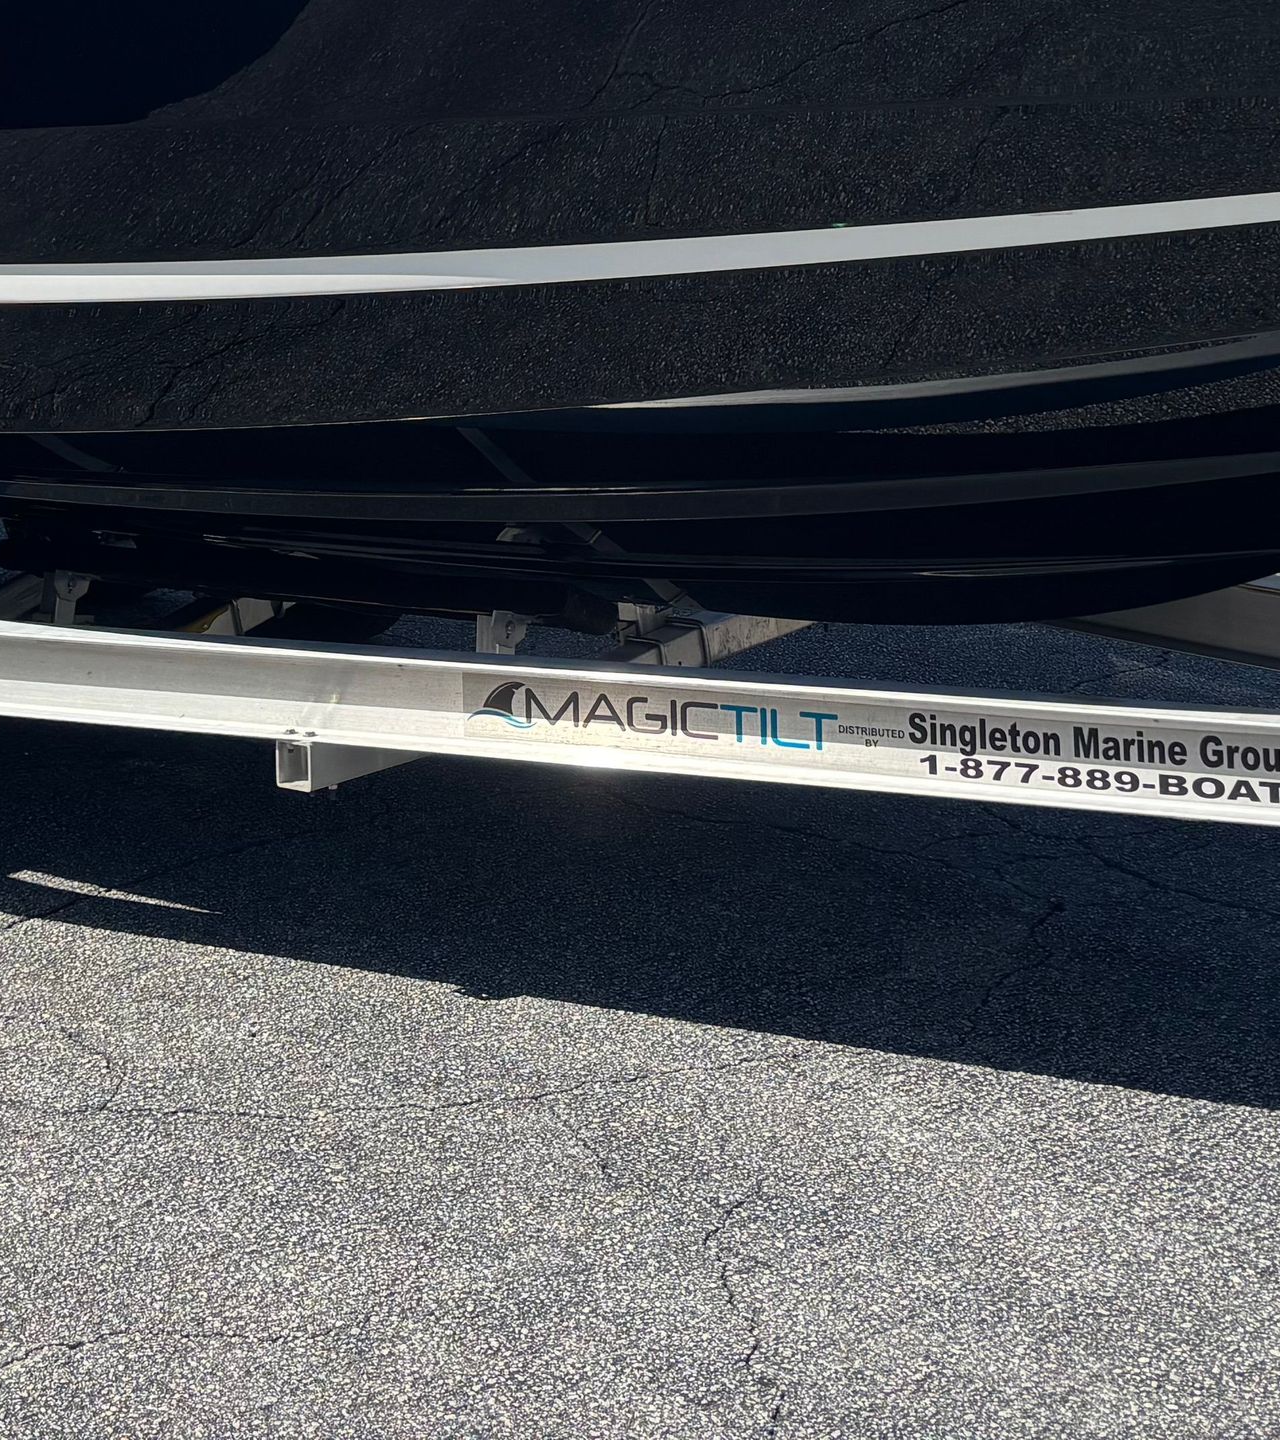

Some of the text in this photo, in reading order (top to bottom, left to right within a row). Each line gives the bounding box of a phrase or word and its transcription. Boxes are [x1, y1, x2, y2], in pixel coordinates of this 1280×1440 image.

[838, 724, 906, 740] DISTRIBUTED
[908, 712, 1061, 757] Singleton
[1073, 726, 1188, 766] Marine
[864, 738, 880, 748] BY
